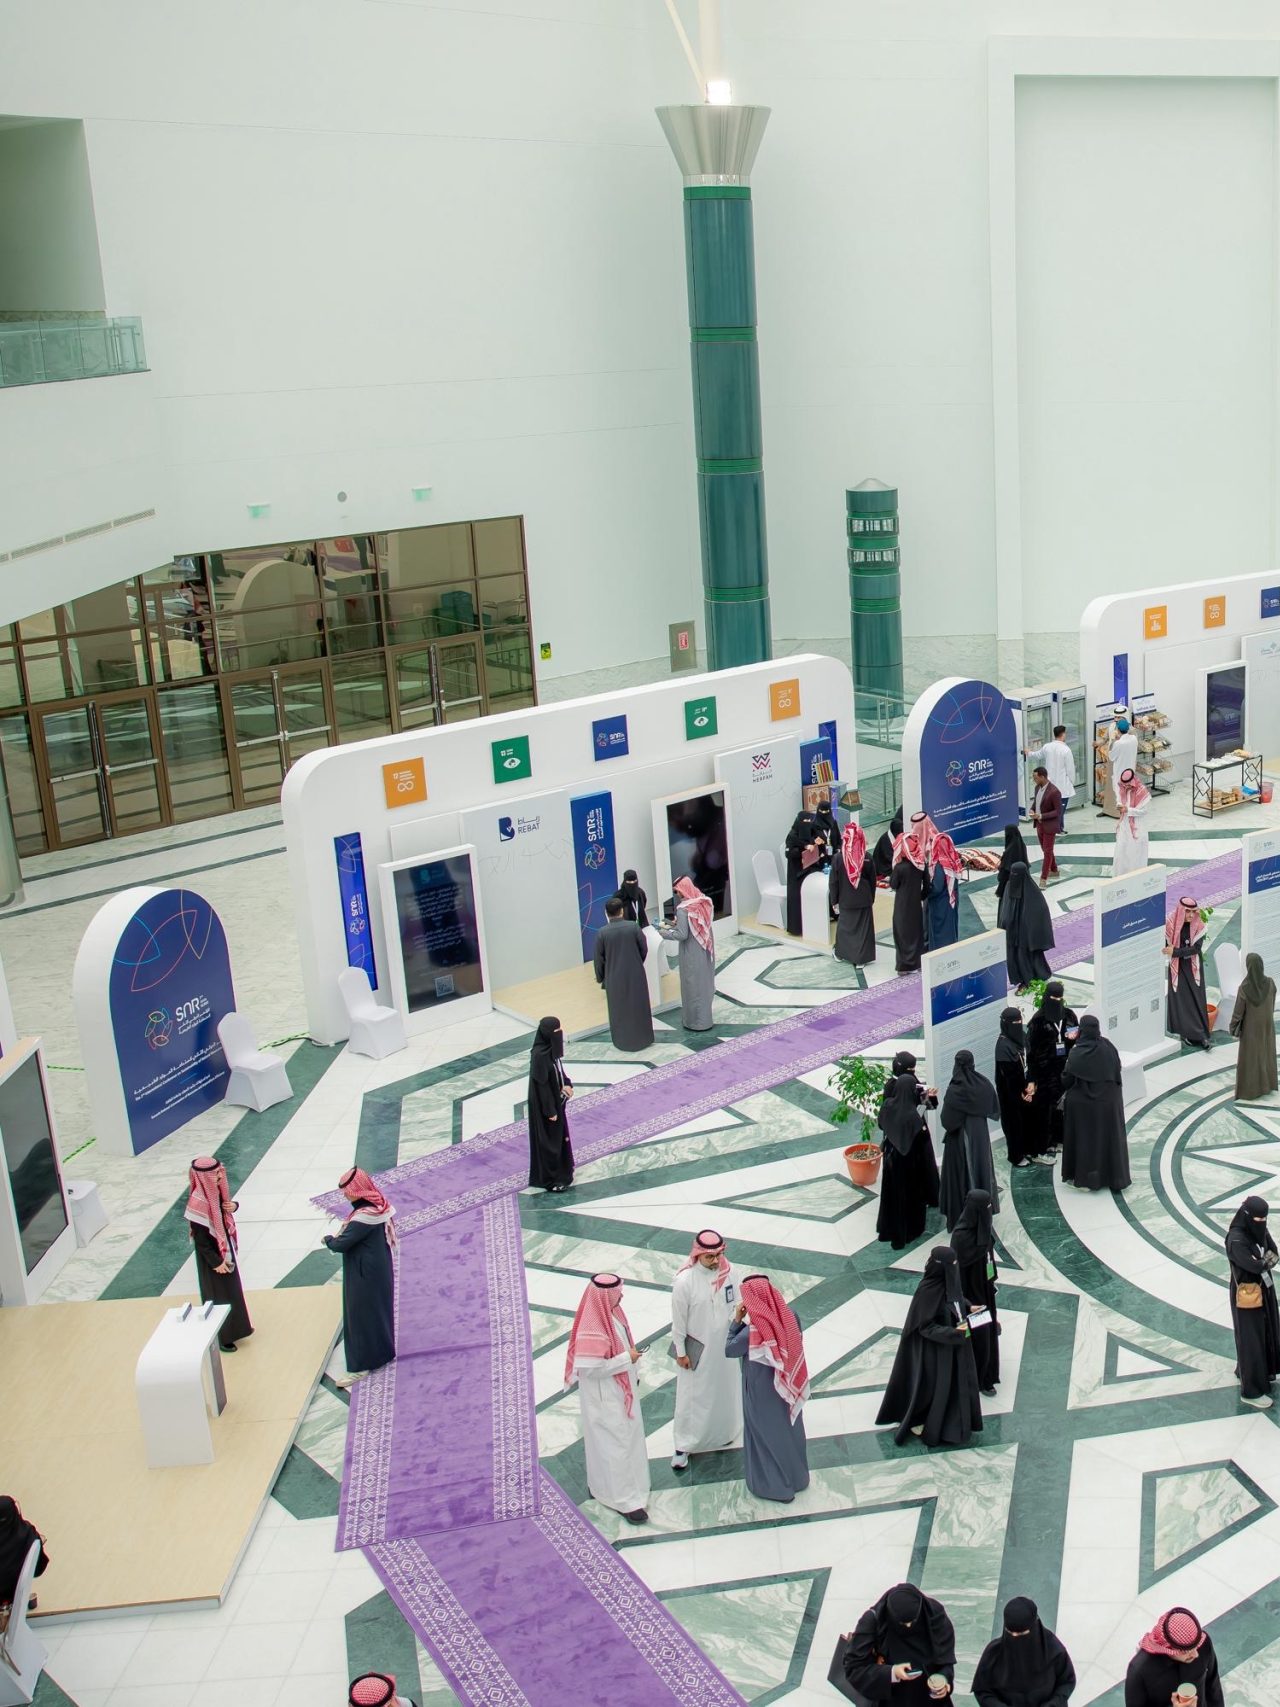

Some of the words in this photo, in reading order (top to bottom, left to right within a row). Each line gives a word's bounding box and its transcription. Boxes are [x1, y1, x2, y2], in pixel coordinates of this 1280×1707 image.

[968, 759, 986, 773] SNR
[518, 824, 540, 834] REBAT
[587, 818, 596, 842] SNR
[176, 998, 200, 1022] SNR
